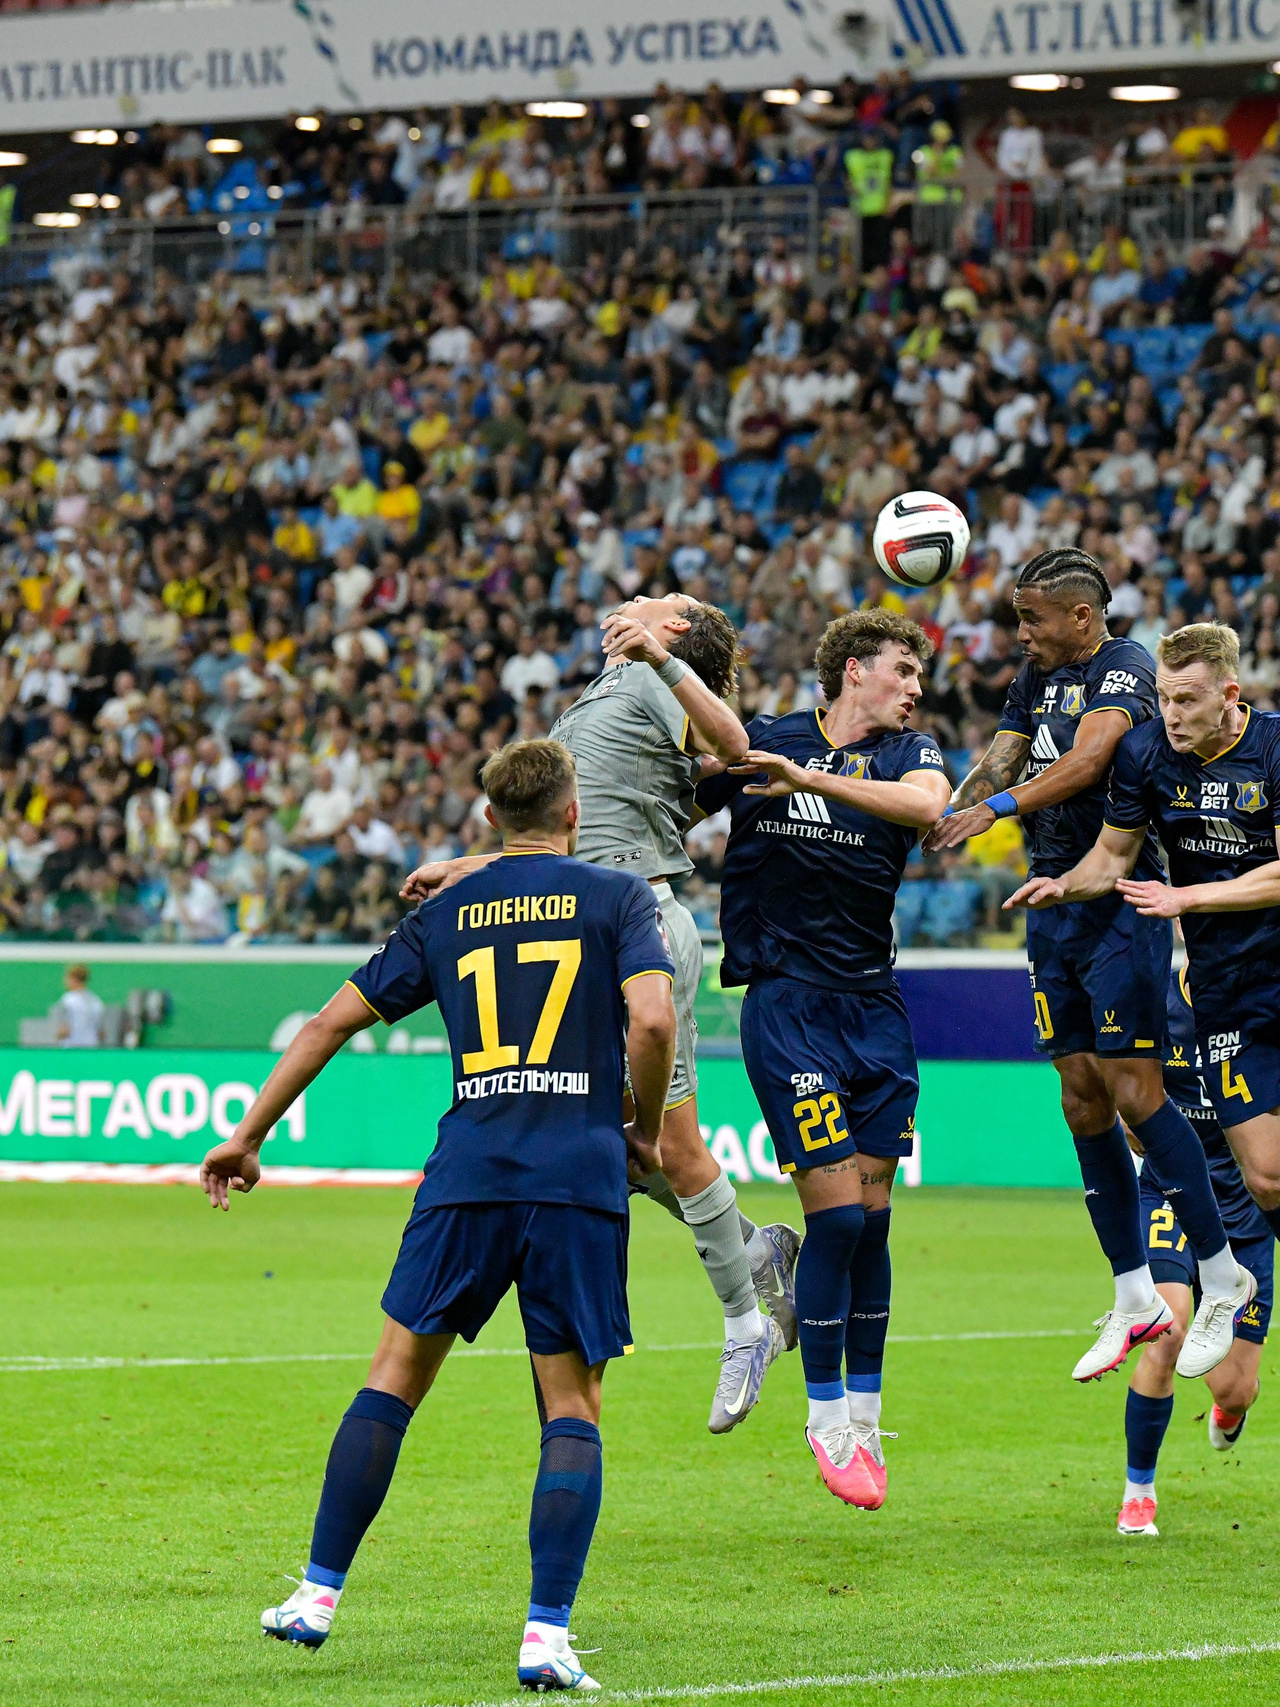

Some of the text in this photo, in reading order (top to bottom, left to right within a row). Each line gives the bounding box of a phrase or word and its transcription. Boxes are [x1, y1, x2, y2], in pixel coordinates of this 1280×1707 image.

[372, 18, 781, 78] КОМАНДА УСПЕХА
[1100, 681, 1135, 694] BET
[1105, 670, 1138, 687] FON
[1200, 782, 1229, 796] FON
[1200, 796, 1229, 810] BET
[756, 820, 865, 846] АТЛАНТИС-ПАК
[457, 895, 577, 931] ГОЛЕНКОВ
[457, 939, 582, 1075] 17
[1208, 1030, 1240, 1050] FON
[1209, 1044, 1243, 1064] BET
[456, 1069, 590, 1101] РОСТСЕЛЬМАШ
[790, 1072, 823, 1086] FON
[1221, 1059, 1254, 1104] 4
[793, 1092, 849, 1152] 22
